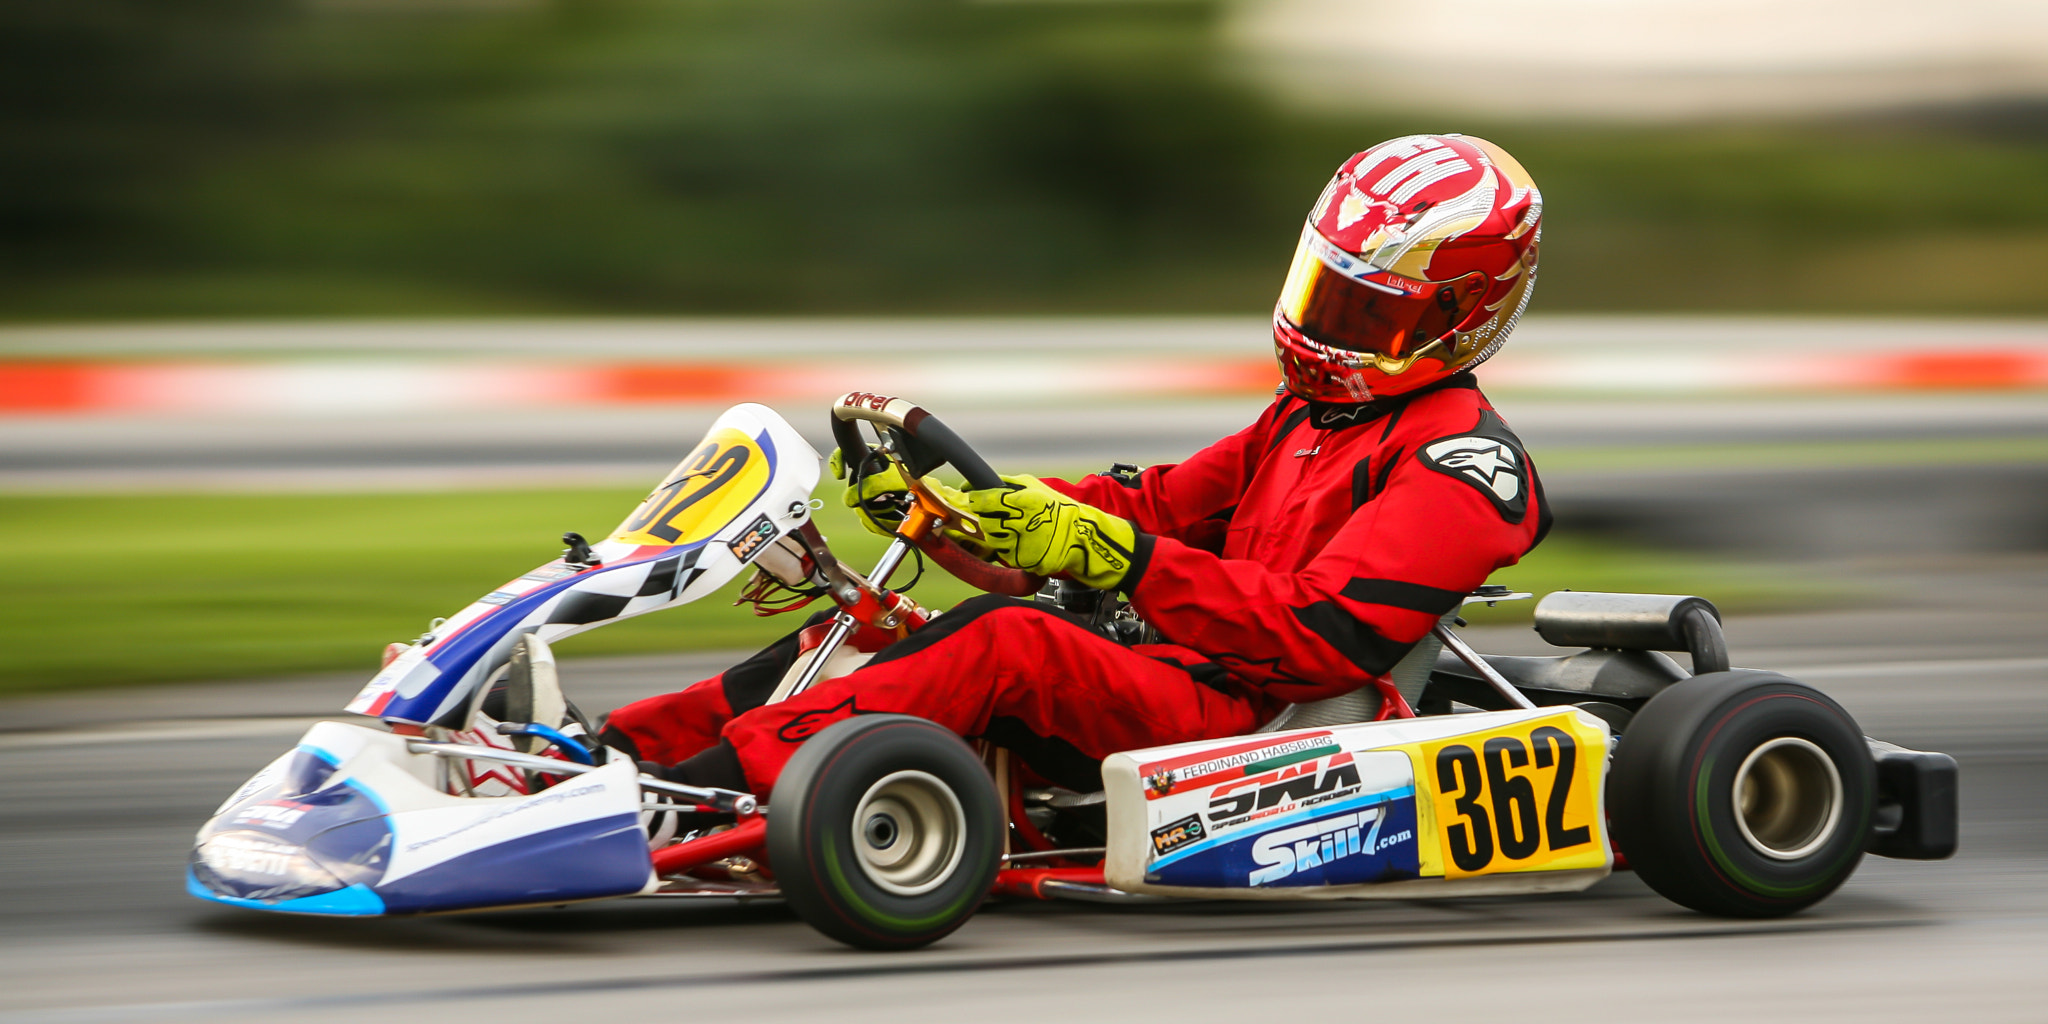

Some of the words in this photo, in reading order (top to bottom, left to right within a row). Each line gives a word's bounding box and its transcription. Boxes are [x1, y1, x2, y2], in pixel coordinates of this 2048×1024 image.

[1183, 751, 1260, 779] FERDINAND
[1262, 736, 1333, 758] HABSBURG
[1208, 752, 1362, 822] SWA
[1301, 785, 1362, 808] ACADEMY
[1436, 726, 1591, 872] 362
